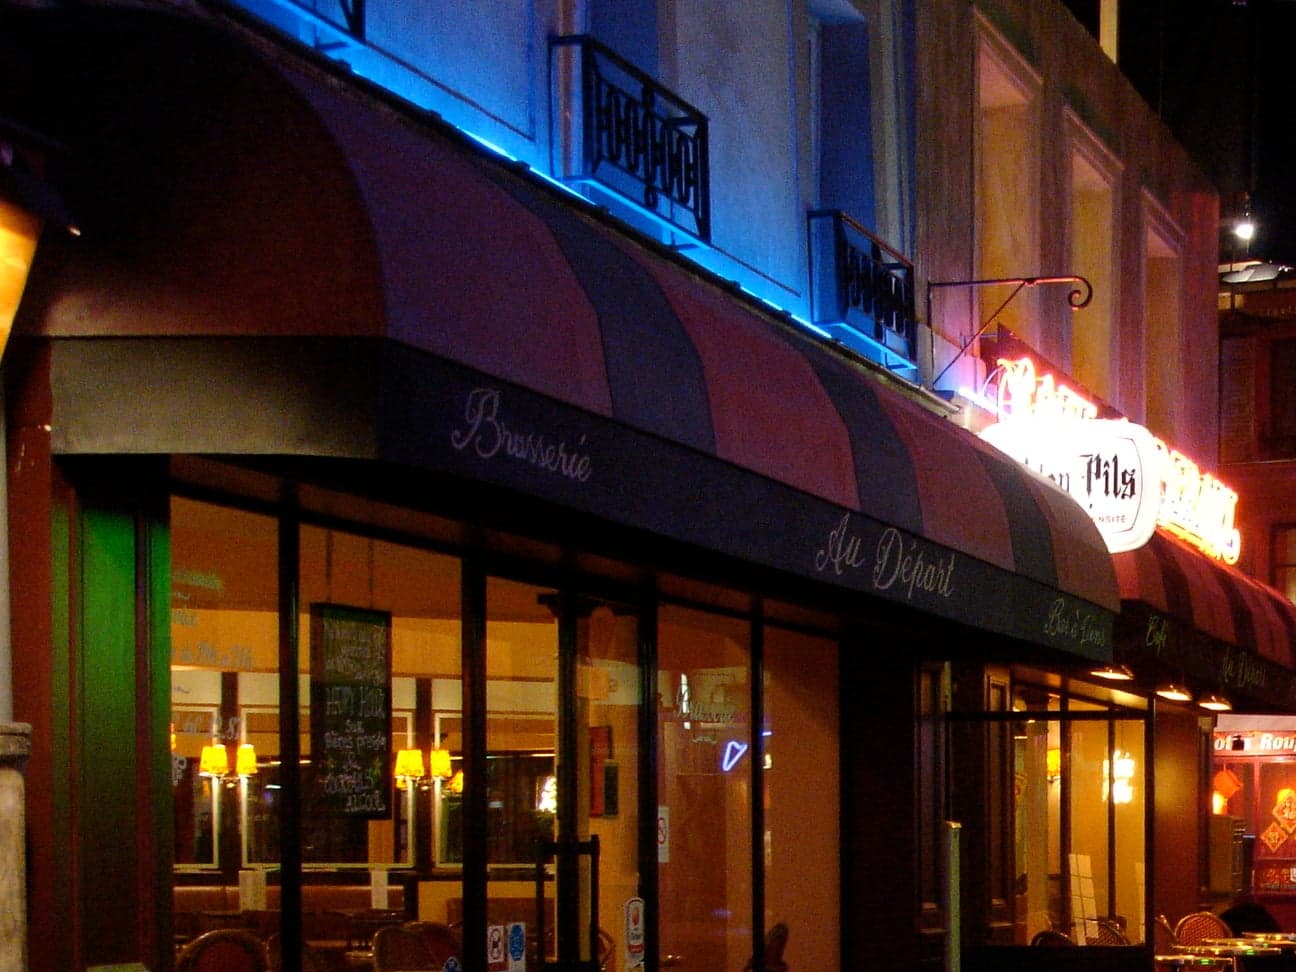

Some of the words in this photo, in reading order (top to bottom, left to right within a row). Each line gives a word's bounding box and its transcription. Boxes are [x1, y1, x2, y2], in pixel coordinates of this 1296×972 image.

[451, 387, 592, 482] Brasserie
[1080, 453, 1137, 499] Pils
[815, 512, 865, 576] Au
[872, 528, 957, 600] Départ
